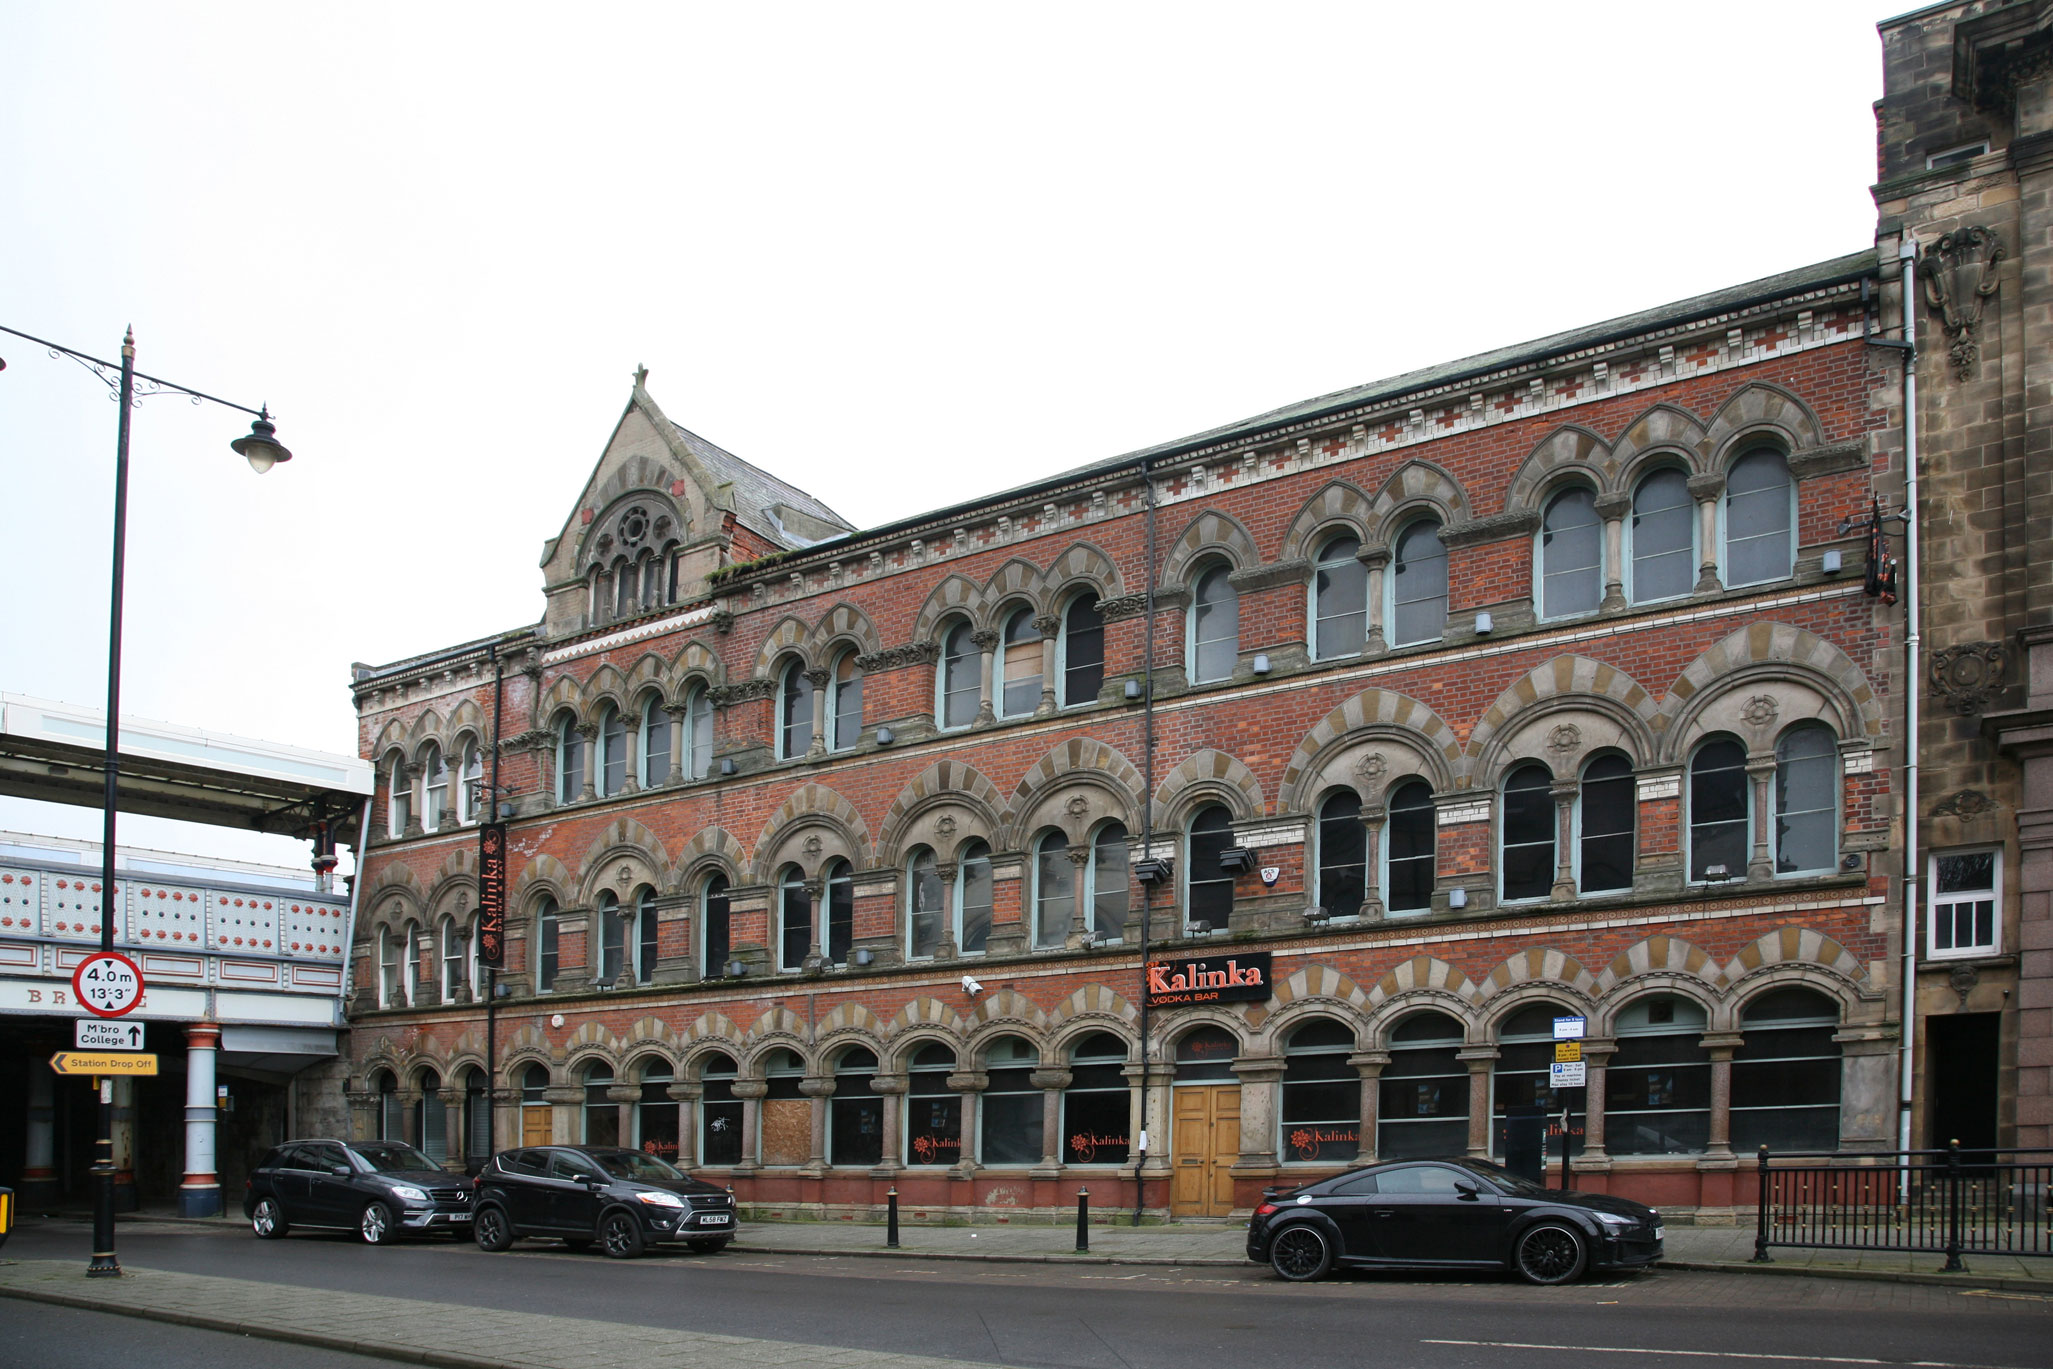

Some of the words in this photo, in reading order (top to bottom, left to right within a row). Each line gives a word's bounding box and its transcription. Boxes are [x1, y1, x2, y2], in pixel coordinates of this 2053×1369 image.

[481, 859, 497, 931] Kalinka
[87, 968, 117, 982] 4.0
[120, 974, 132, 982] m
[1150, 960, 1264, 994] Kalinka
[1194, 992, 1219, 1001] BAR
[87, 1024, 120, 1034] M'bro
[81, 1034, 125, 1045] College
[71, 1059, 107, 1068] Station
[110, 1059, 133, 1069] Drop
[136, 1060, 152, 1068] Off
[1091, 1135, 1130, 1145] Kalinka
[1315, 1130, 1360, 1141] Kalinka
[932, 1137, 961, 1147] Kalink
